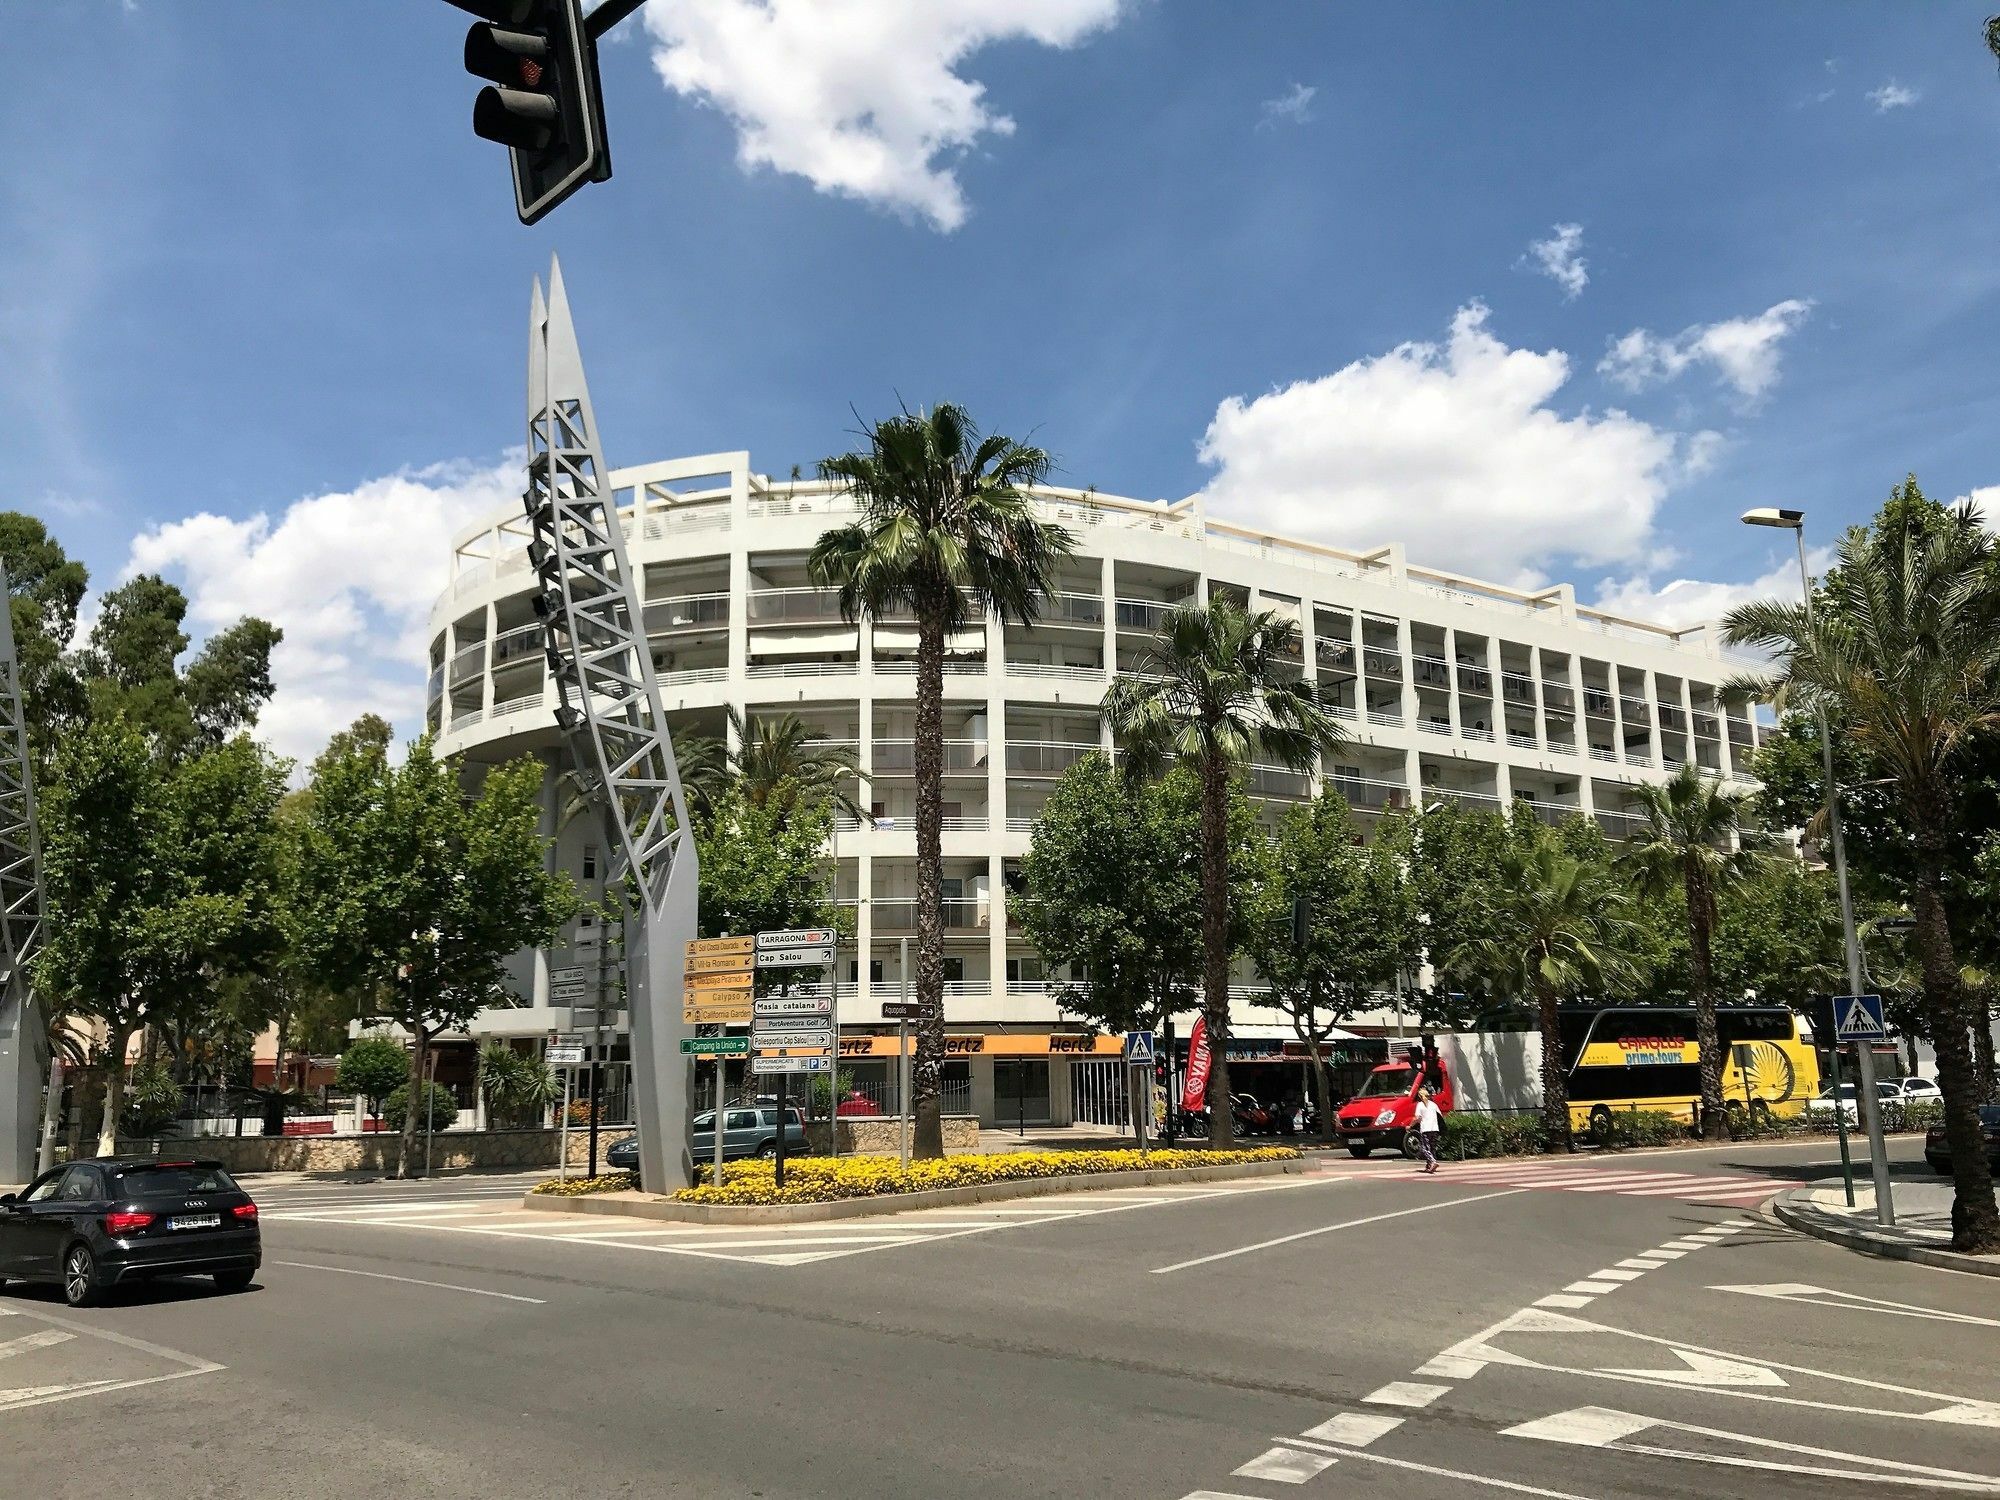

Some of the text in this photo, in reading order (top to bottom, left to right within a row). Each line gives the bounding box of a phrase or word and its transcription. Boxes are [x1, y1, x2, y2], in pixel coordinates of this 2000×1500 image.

[761, 935, 806, 943] TARRAGONA
[760, 954, 775, 962] Cap
[713, 993, 741, 1001] Calypso
[703, 1010, 729, 1019] California
[784, 1037, 793, 1045] Cap
[944, 1038, 983, 1052] ertz
[1049, 1035, 1094, 1052] Hertz
[1618, 1037, 1685, 1050] CAROLUS
[693, 1041, 715, 1051] Camping
[173, 1216, 198, 1226] 9426
